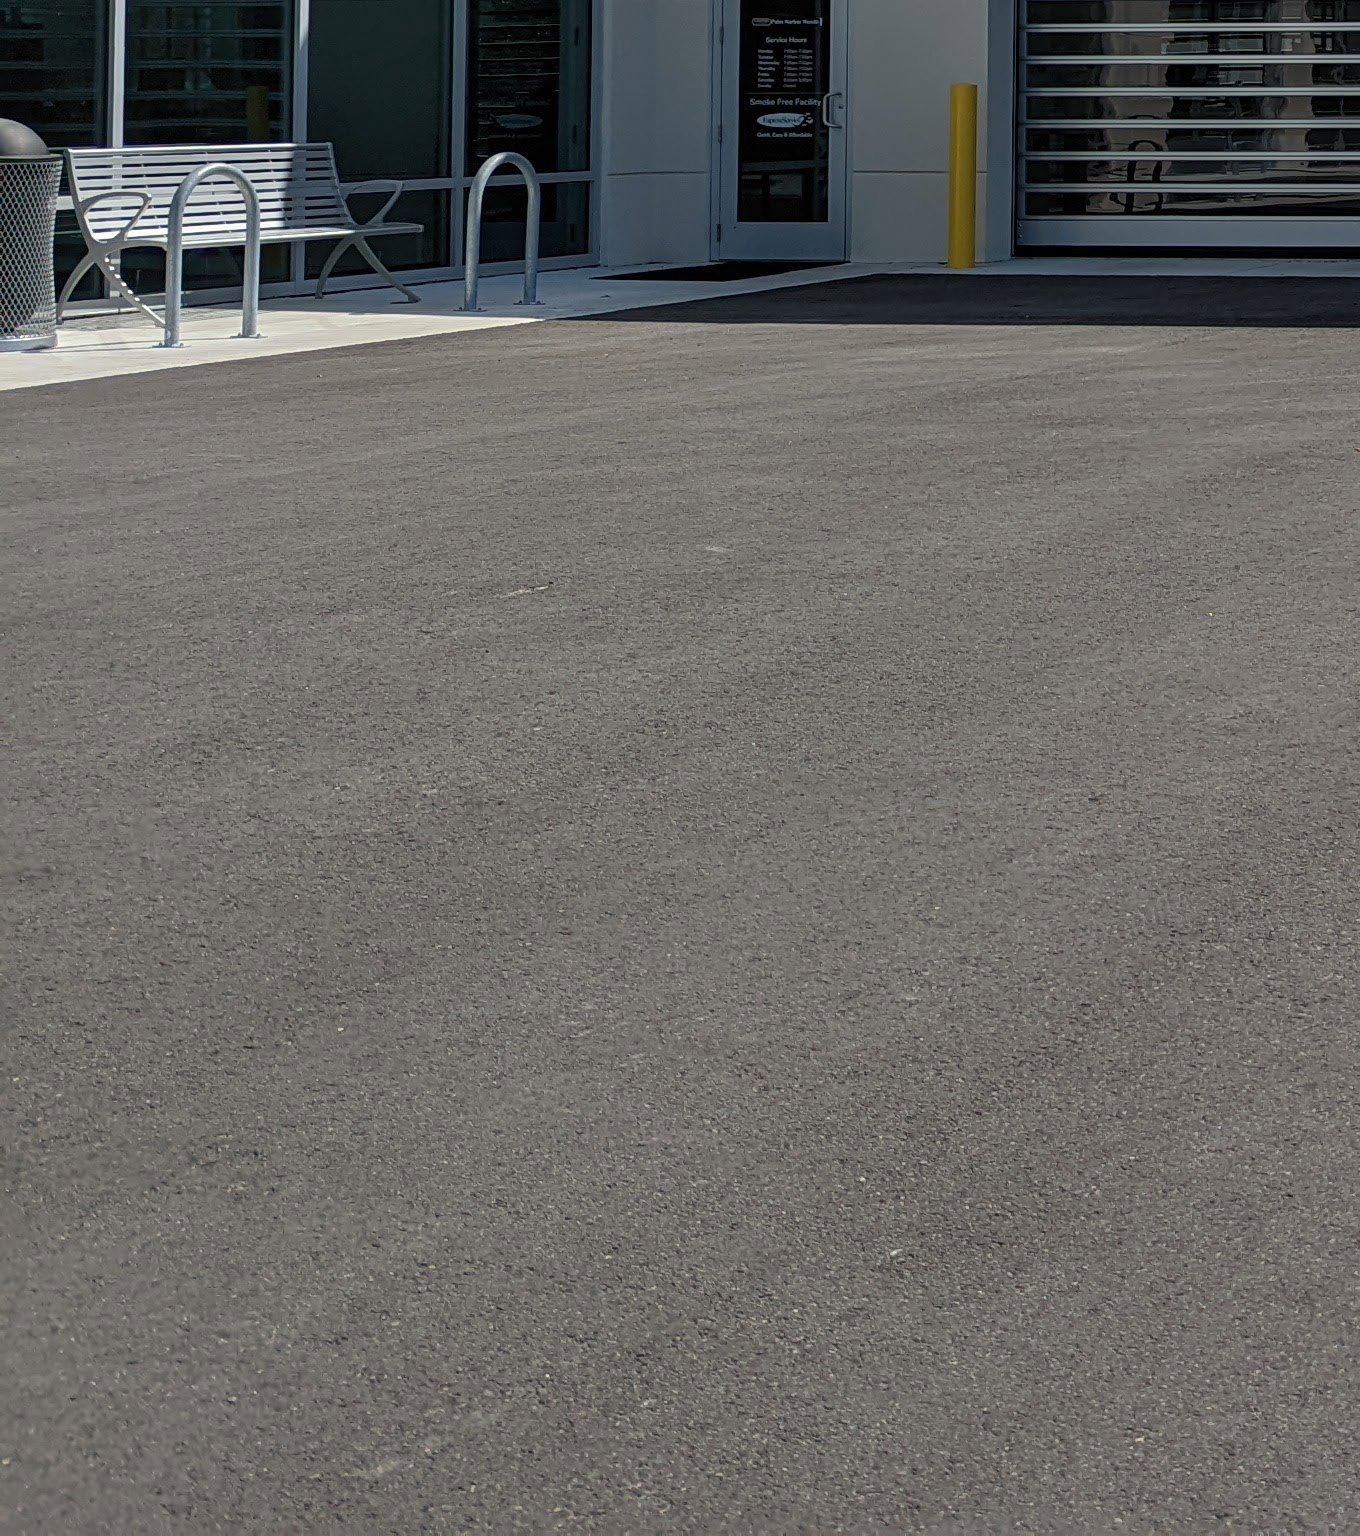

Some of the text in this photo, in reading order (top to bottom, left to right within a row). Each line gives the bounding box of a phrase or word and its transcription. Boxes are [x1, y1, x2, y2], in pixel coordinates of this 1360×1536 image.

[749, 98, 821, 107] Smoke Free Facility
